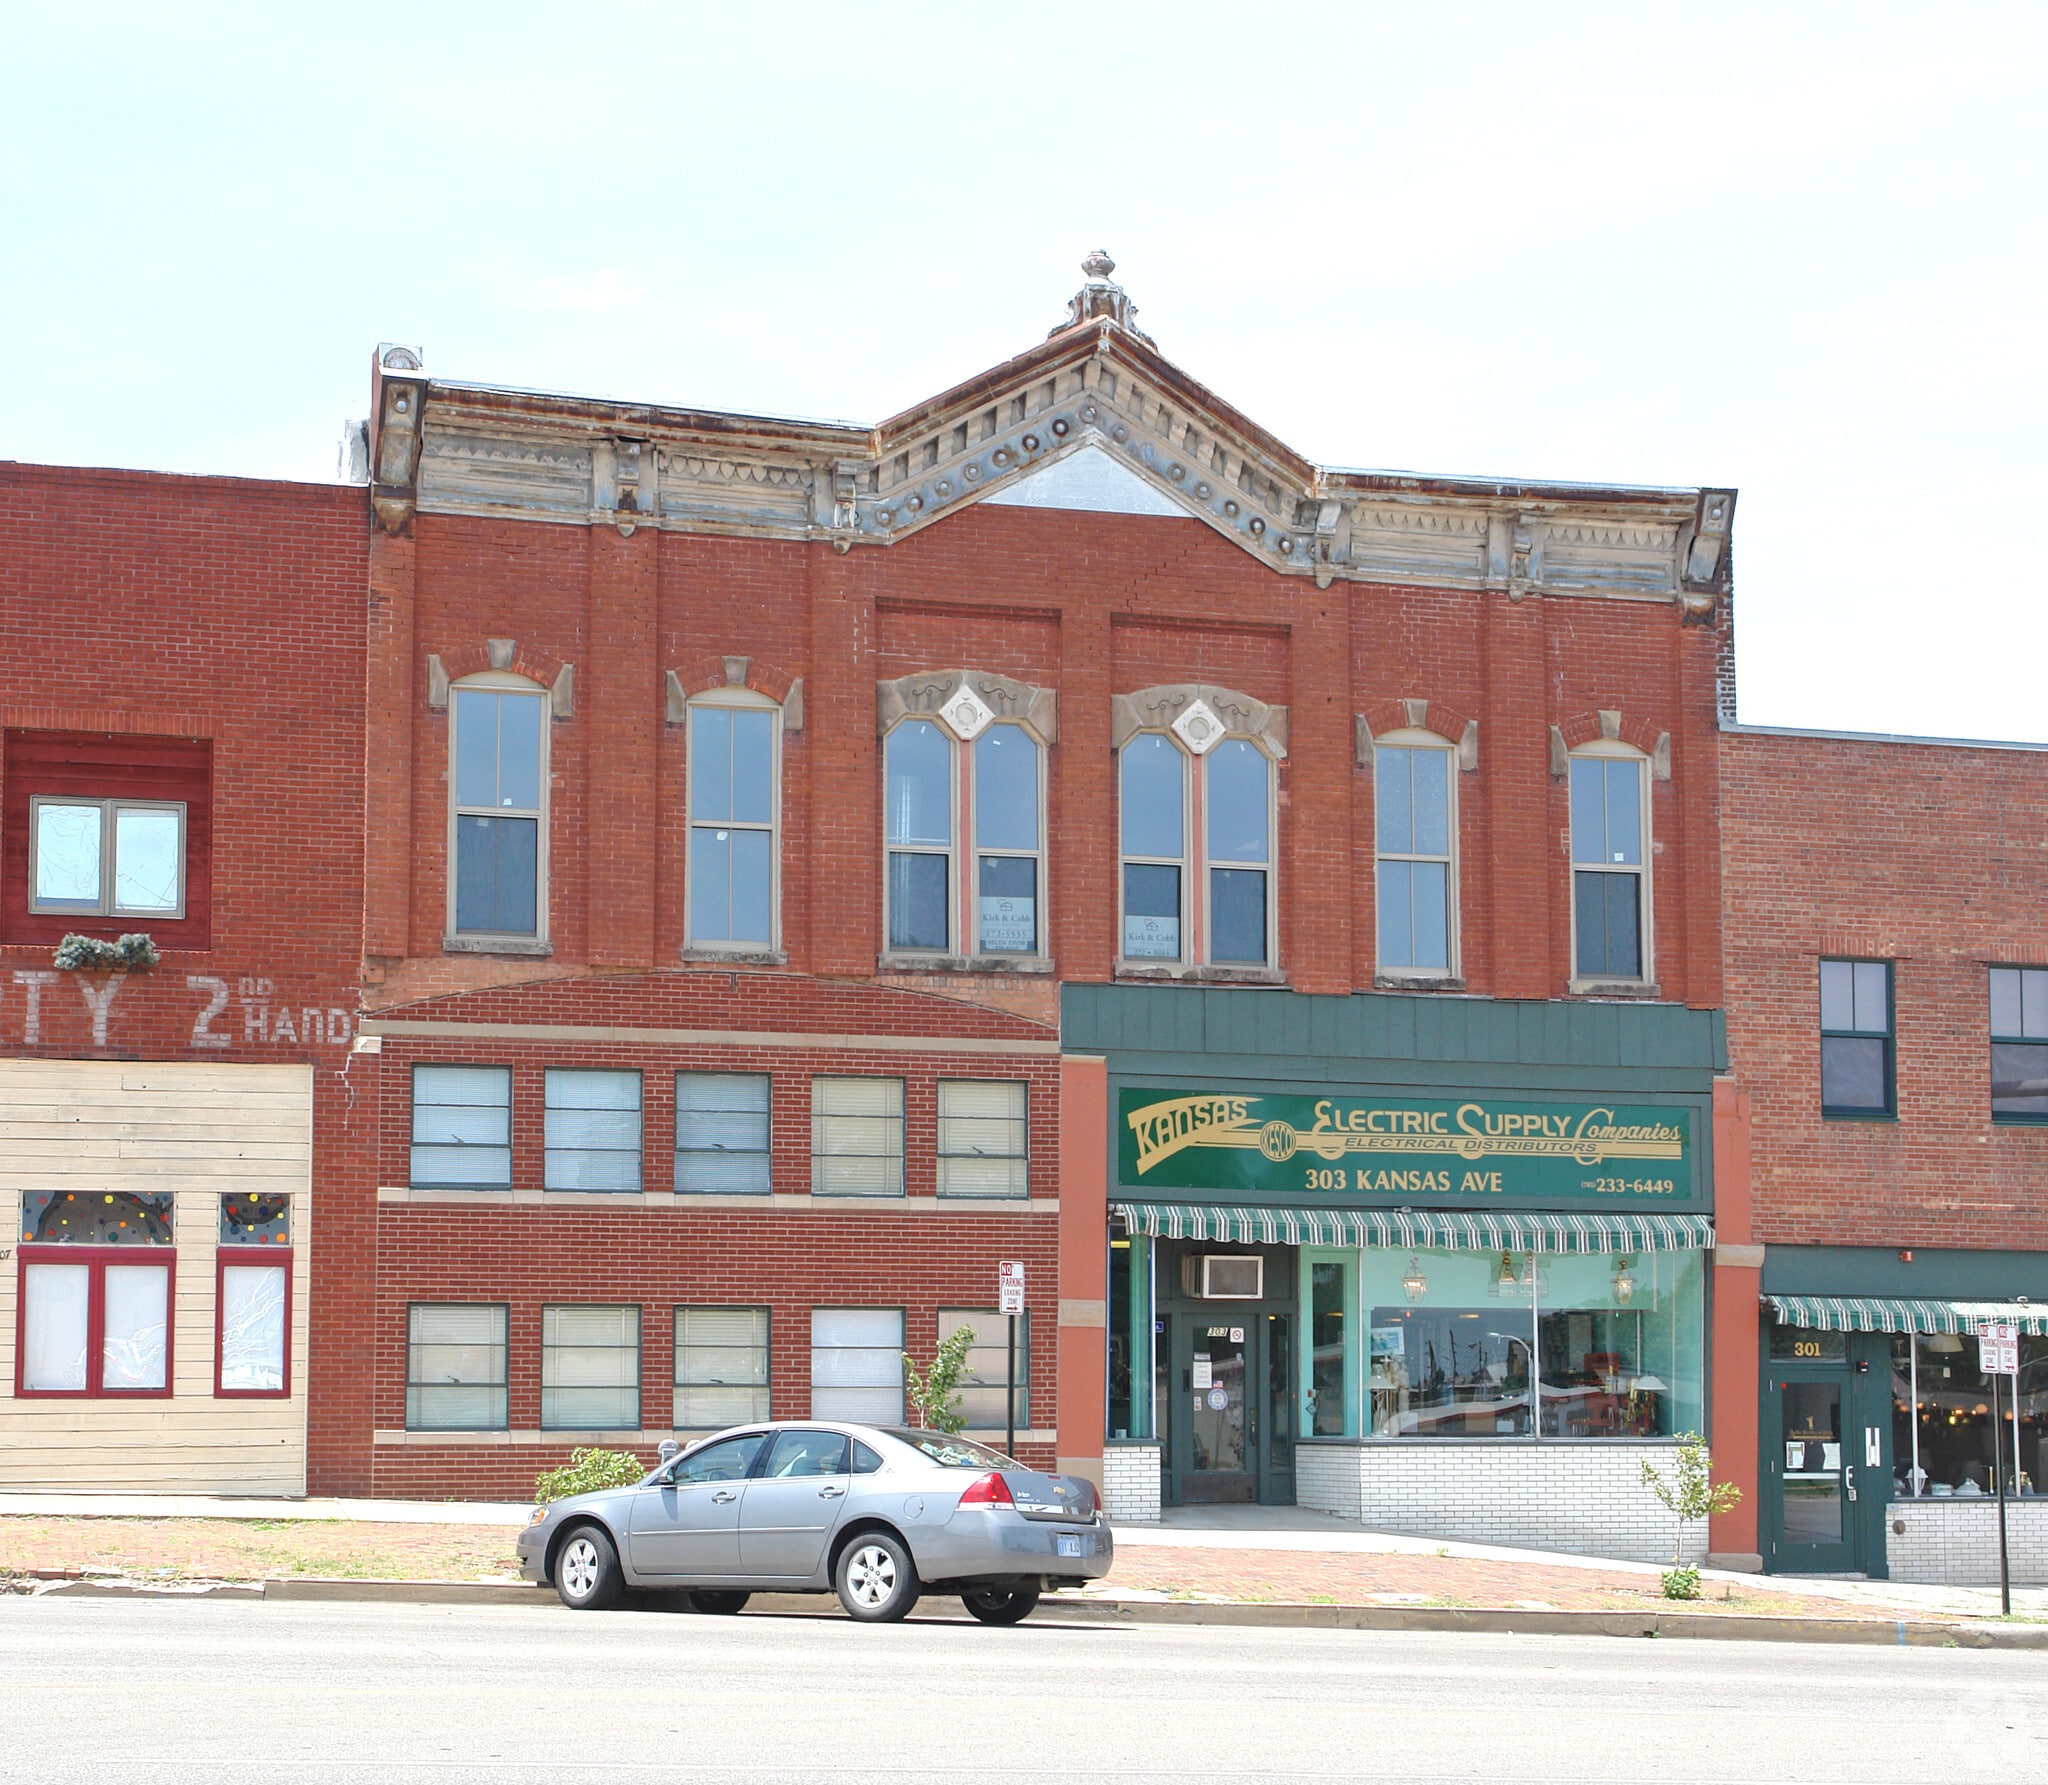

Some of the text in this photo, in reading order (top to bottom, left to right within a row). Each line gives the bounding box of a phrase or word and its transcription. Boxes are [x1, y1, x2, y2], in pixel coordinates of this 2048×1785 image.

[243, 1006, 351, 1044] HAND
[1130, 1099, 1250, 1163] KANSAS
[1311, 1100, 1683, 1165] ELECTRIC SUPPLY Companies
[1344, 1137, 1598, 1153] ELECTRICAL DISTRIBUTORS
[1304, 1168, 1503, 1193] 303 KANSAS AVE
[1596, 1177, 1674, 1194] 233-6449
[1001, 1263, 1012, 1275] NO
[1001, 1277, 1023, 1288] PARKING
[1208, 1326, 1227, 1336] 303
[1794, 1341, 1821, 1357] 301
